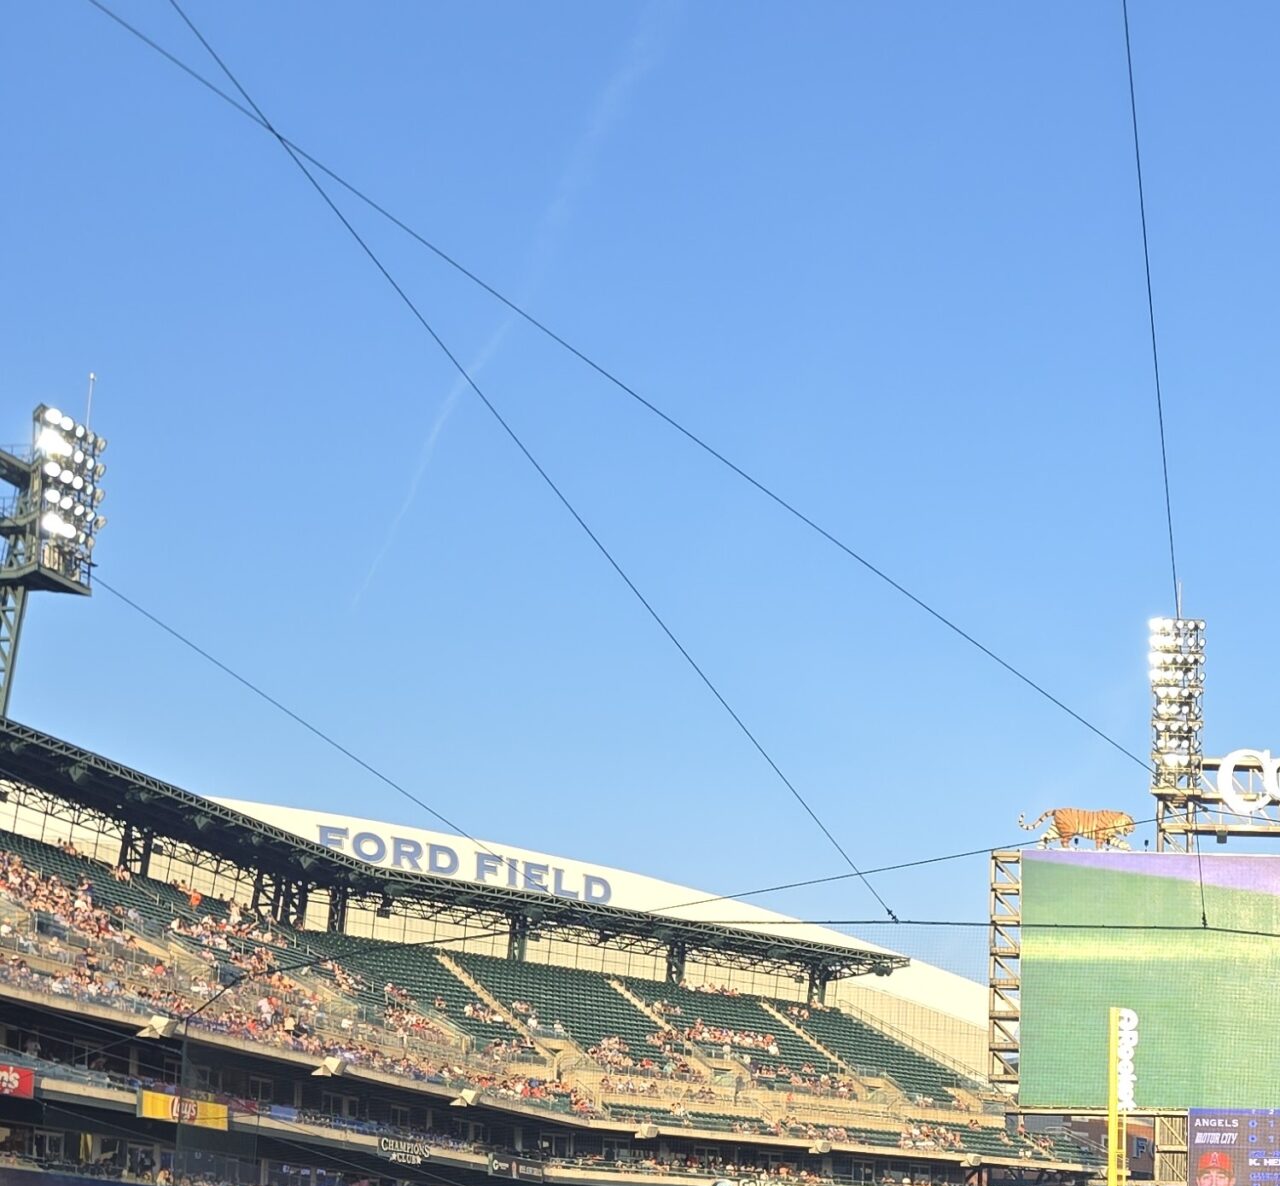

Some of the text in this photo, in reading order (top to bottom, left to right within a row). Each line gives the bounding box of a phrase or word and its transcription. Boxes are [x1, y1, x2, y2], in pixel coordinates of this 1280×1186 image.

[316, 824, 612, 905] FORD FIELD
[1194, 1118, 1239, 1127] ANGELS
[381, 1137, 430, 1158] CHAMPIONS
[396, 1152, 417, 1165] CLUB
